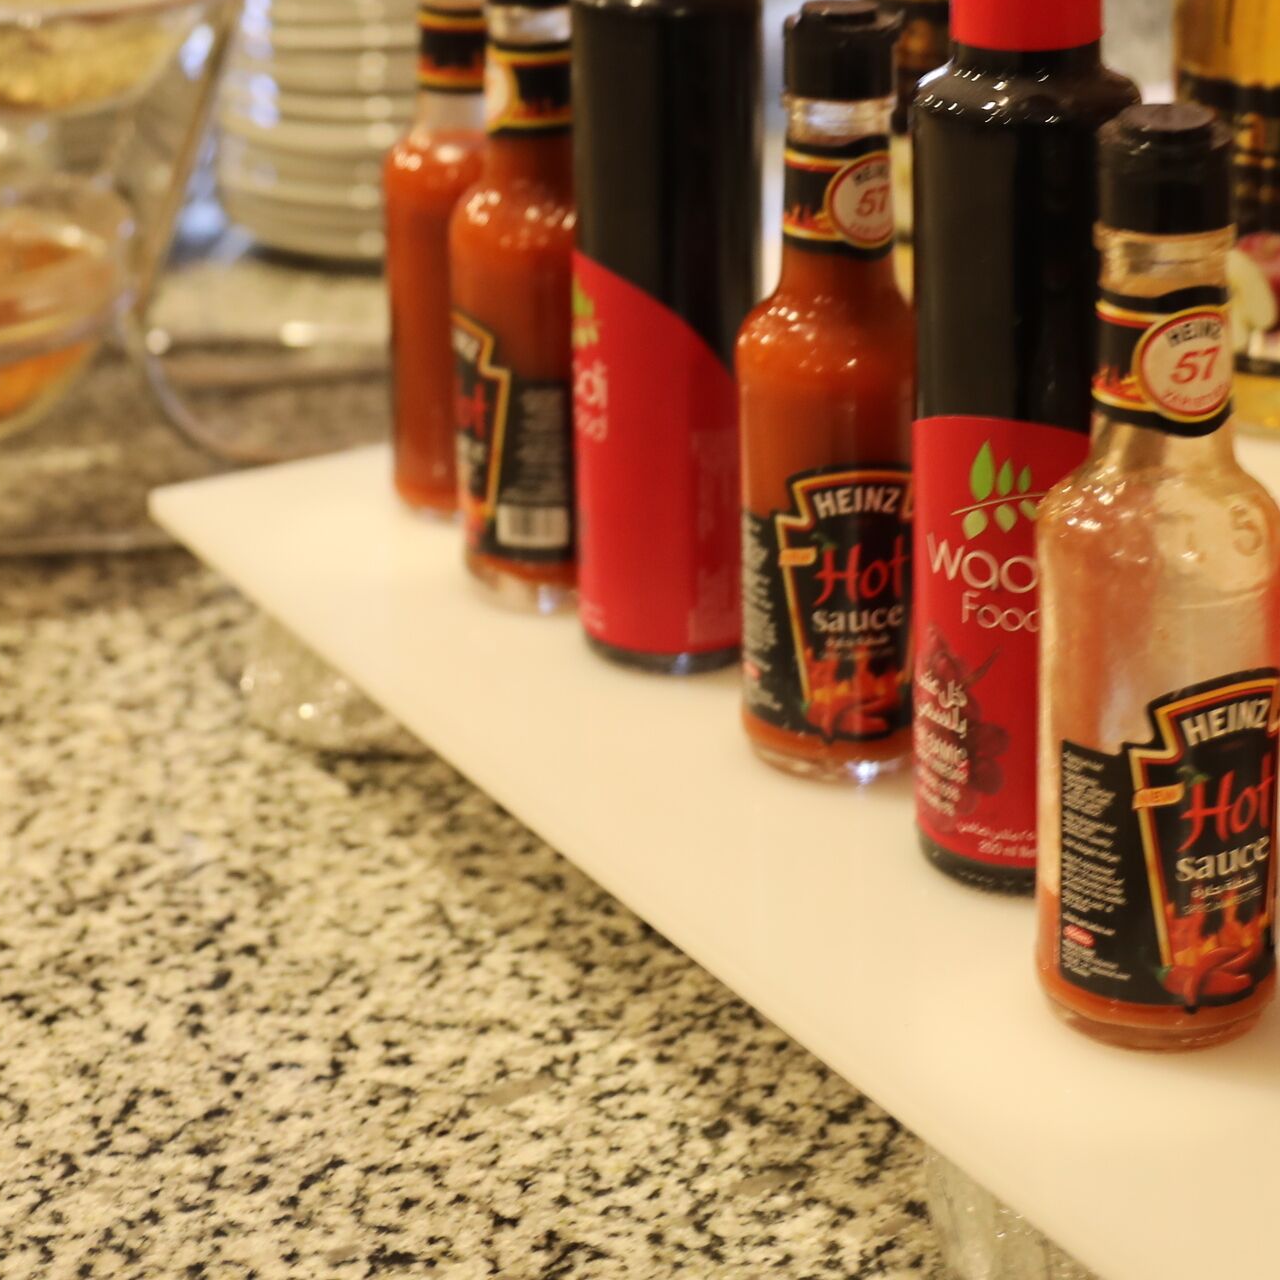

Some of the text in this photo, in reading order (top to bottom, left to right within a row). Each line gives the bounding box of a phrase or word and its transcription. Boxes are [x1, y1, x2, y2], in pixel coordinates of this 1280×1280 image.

[1168, 320, 1223, 348] HEINZ
[1171, 346, 1221, 385] 57
[812, 485, 902, 520] HEINZ
[813, 534, 910, 607] Hot
[811, 604, 904, 634] sauce
[1180, 697, 1272, 747] HEINZ
[1177, 752, 1276, 854] Hot
[1175, 834, 1271, 882] sauce
